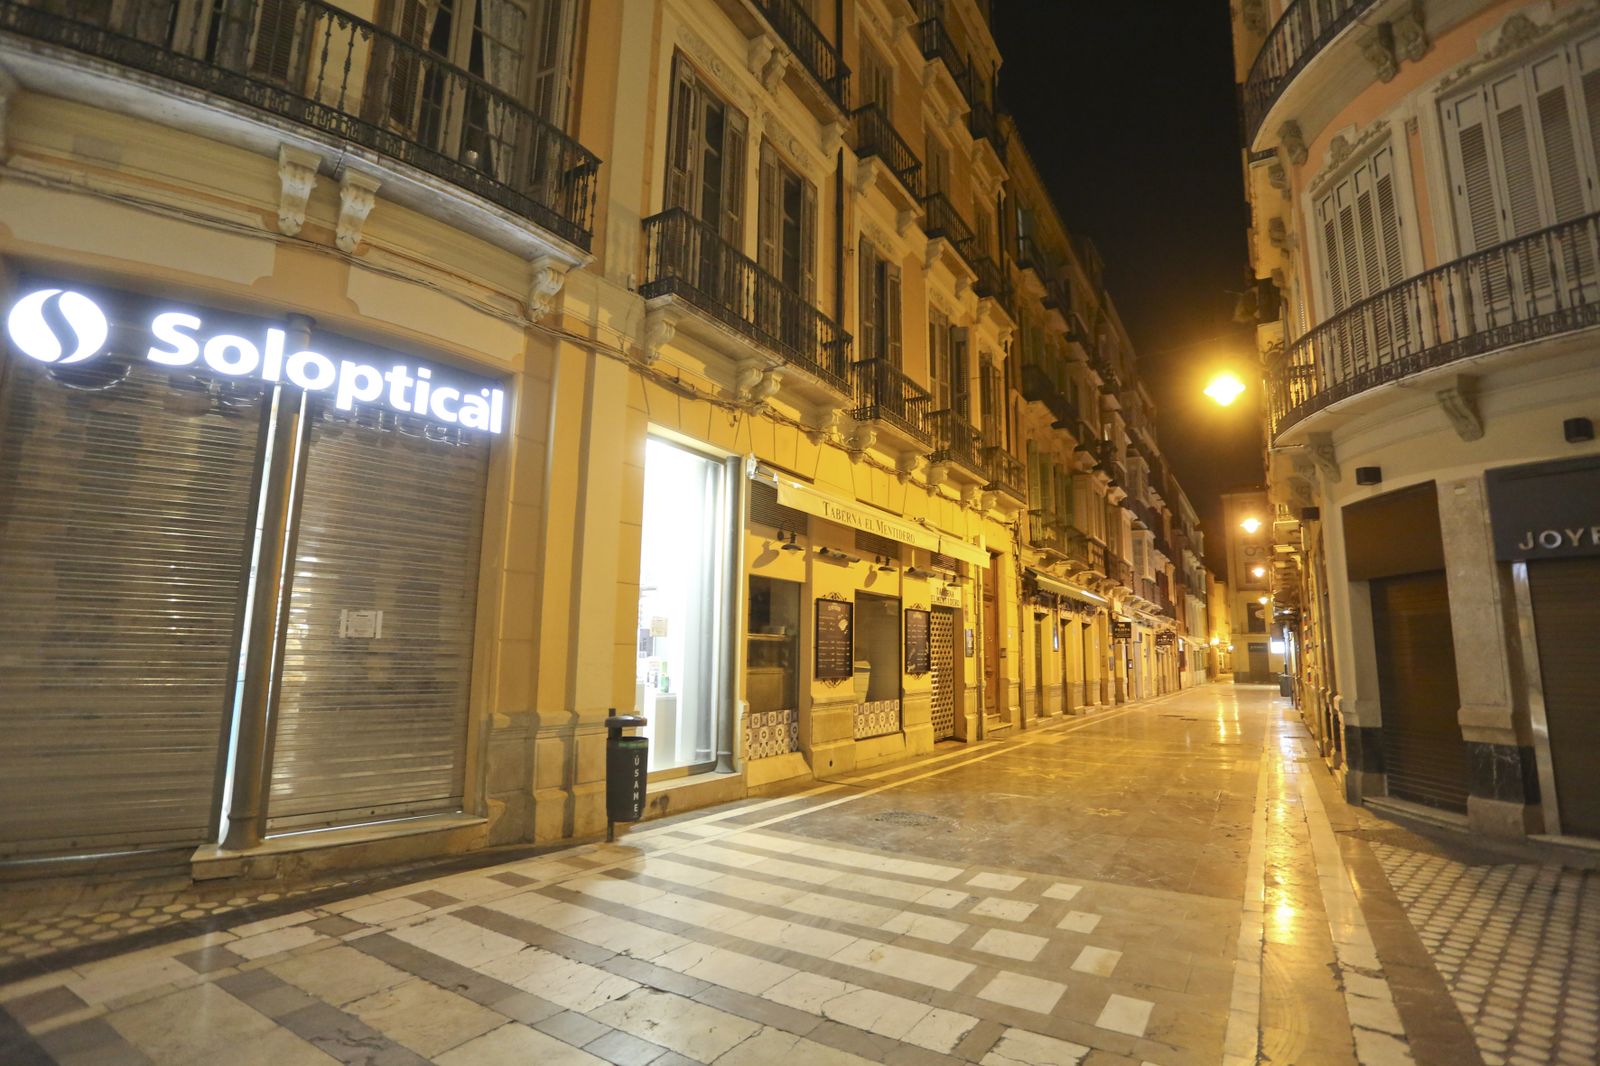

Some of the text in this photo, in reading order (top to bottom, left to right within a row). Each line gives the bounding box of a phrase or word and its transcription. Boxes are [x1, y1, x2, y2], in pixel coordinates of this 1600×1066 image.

[146, 311, 504, 434] Soloptical
[823, 501, 862, 527] TABERNA
[876, 520, 916, 543] MENTIDERO
